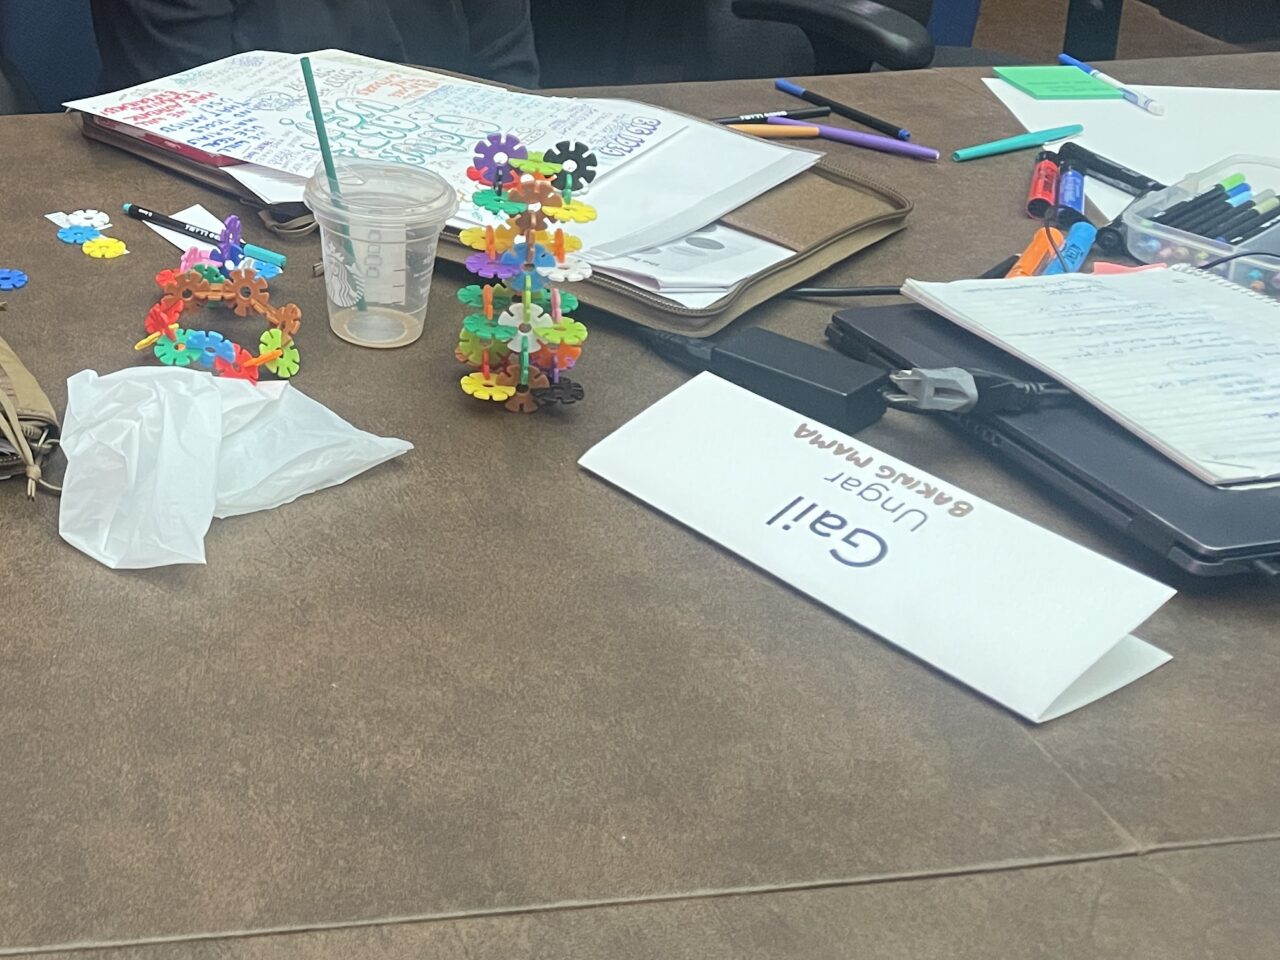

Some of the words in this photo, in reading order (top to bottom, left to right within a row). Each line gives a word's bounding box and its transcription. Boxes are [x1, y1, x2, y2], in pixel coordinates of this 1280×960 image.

[184, 117, 259, 144] MATERIALS
[793, 422, 873, 472] MAMA
[824, 473, 929, 534] Ungar
[877, 464, 975, 518] BAKING
[765, 496, 889, 569] Gail
